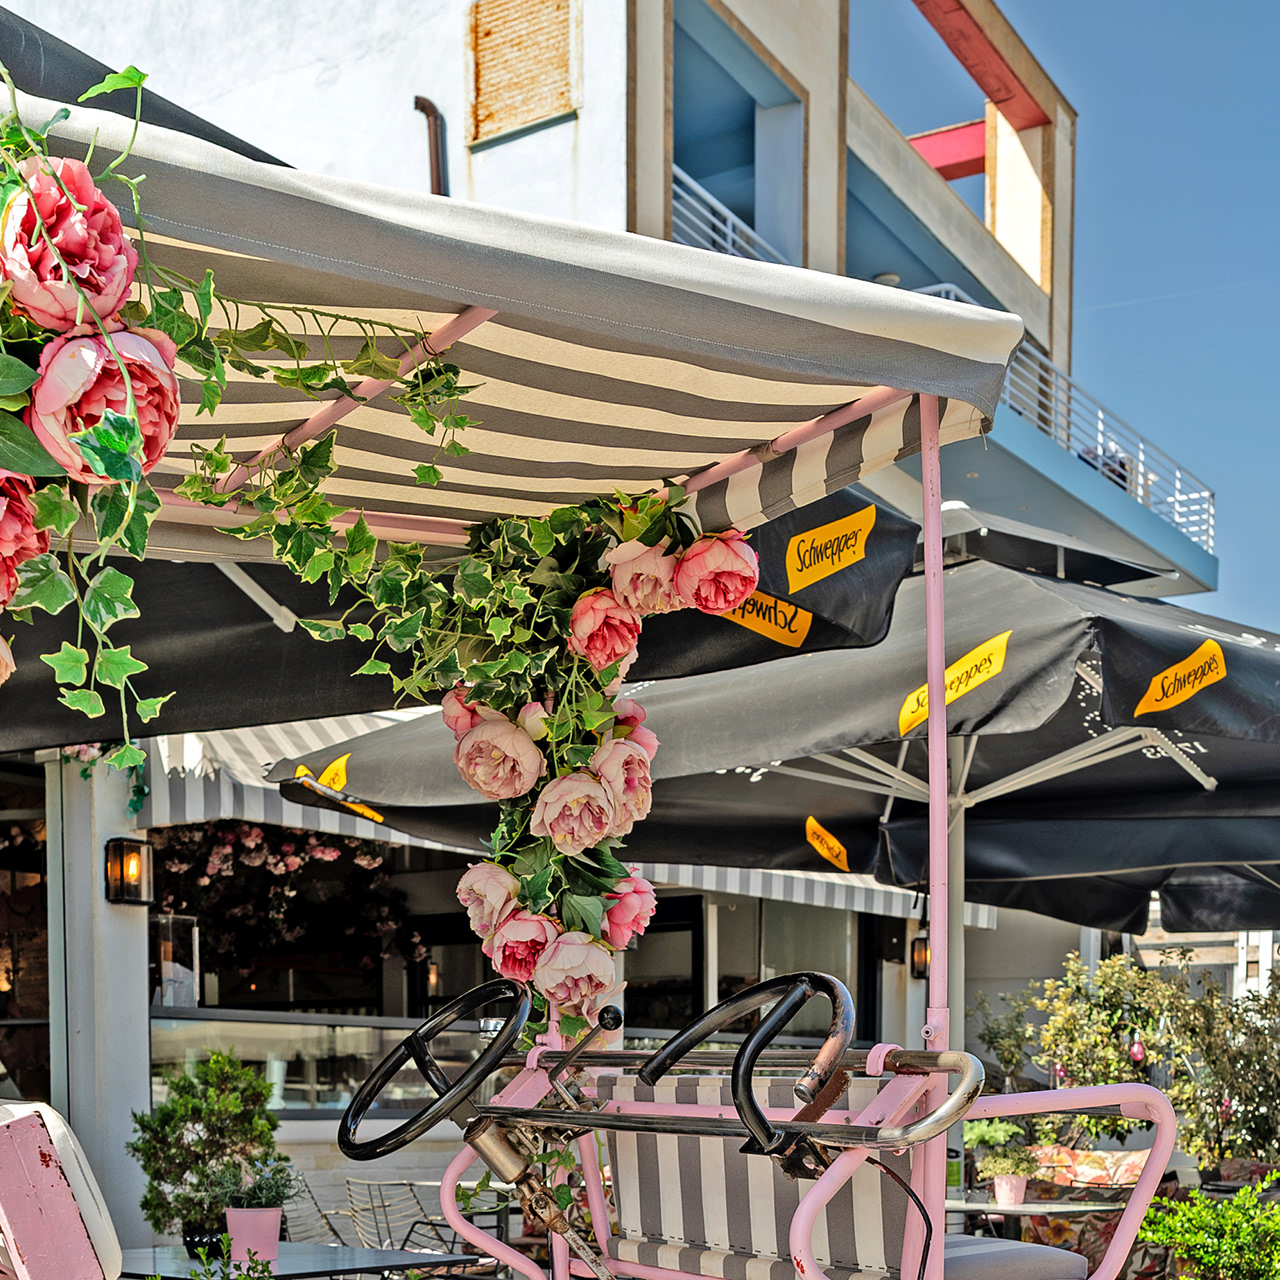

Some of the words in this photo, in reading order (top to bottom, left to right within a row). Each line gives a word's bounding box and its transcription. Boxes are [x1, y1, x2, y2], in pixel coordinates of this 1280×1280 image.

[795, 527, 863, 573] Schweppes
[910, 652, 994, 714] Sceppes
[1154, 653, 1220, 703] Schweppes
